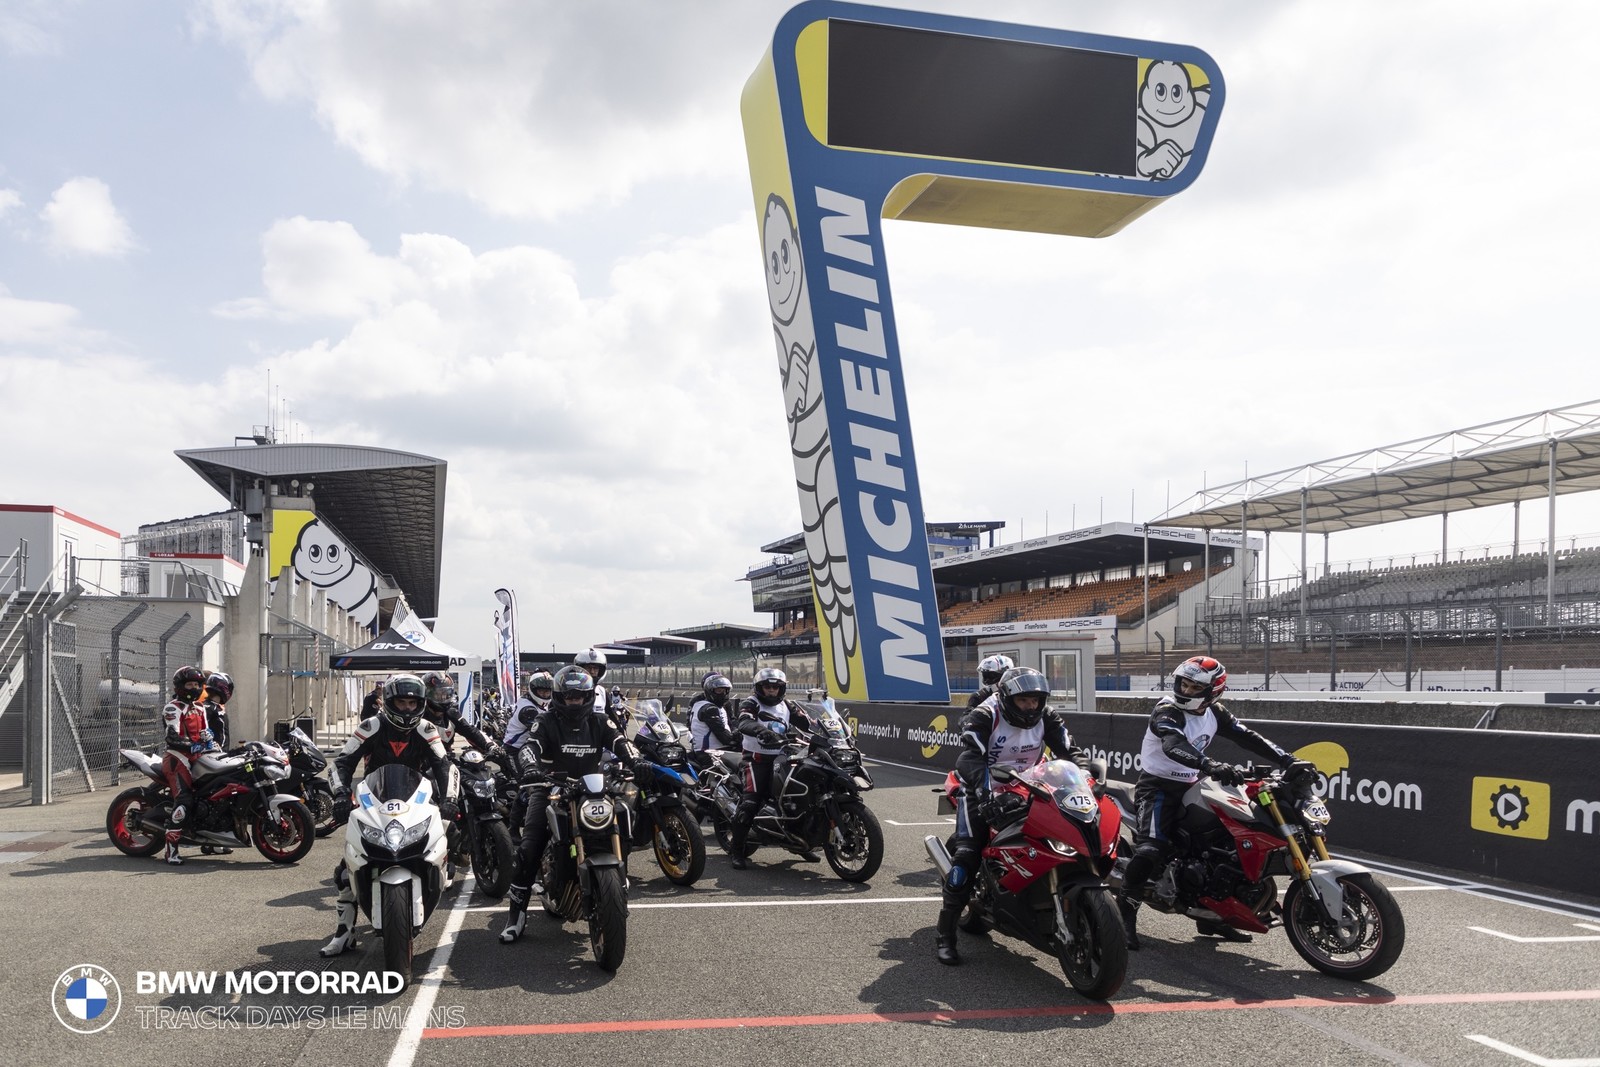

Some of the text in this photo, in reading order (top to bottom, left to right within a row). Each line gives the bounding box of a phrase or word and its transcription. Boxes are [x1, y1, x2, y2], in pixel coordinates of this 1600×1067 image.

[814, 186, 934, 686] MICHELIN
[1058, 527, 1102, 542] PORSCHE
[1133, 526, 1196, 540] PORSCHE
[1023, 539, 1048, 549] #TeamPorsche
[1210, 535, 1243, 545] #TeamPorsc
[980, 545, 1014, 557] PORSCHE
[944, 553, 973, 564] PORSCHE
[945, 619, 1102, 635] PORSCHE PORSCHE #TeamPorsche PORSCHE
[371, 642, 410, 650] BMC
[858, 721, 901, 740] motorsport.tv
[560, 744, 597, 757] Furygan
[1310, 769, 1422, 811] ort.com
[1069, 794, 1091, 806] 175
[387, 802, 400, 811] 61
[591, 805, 604, 815] 20
[1565, 799, 1600, 835] m
